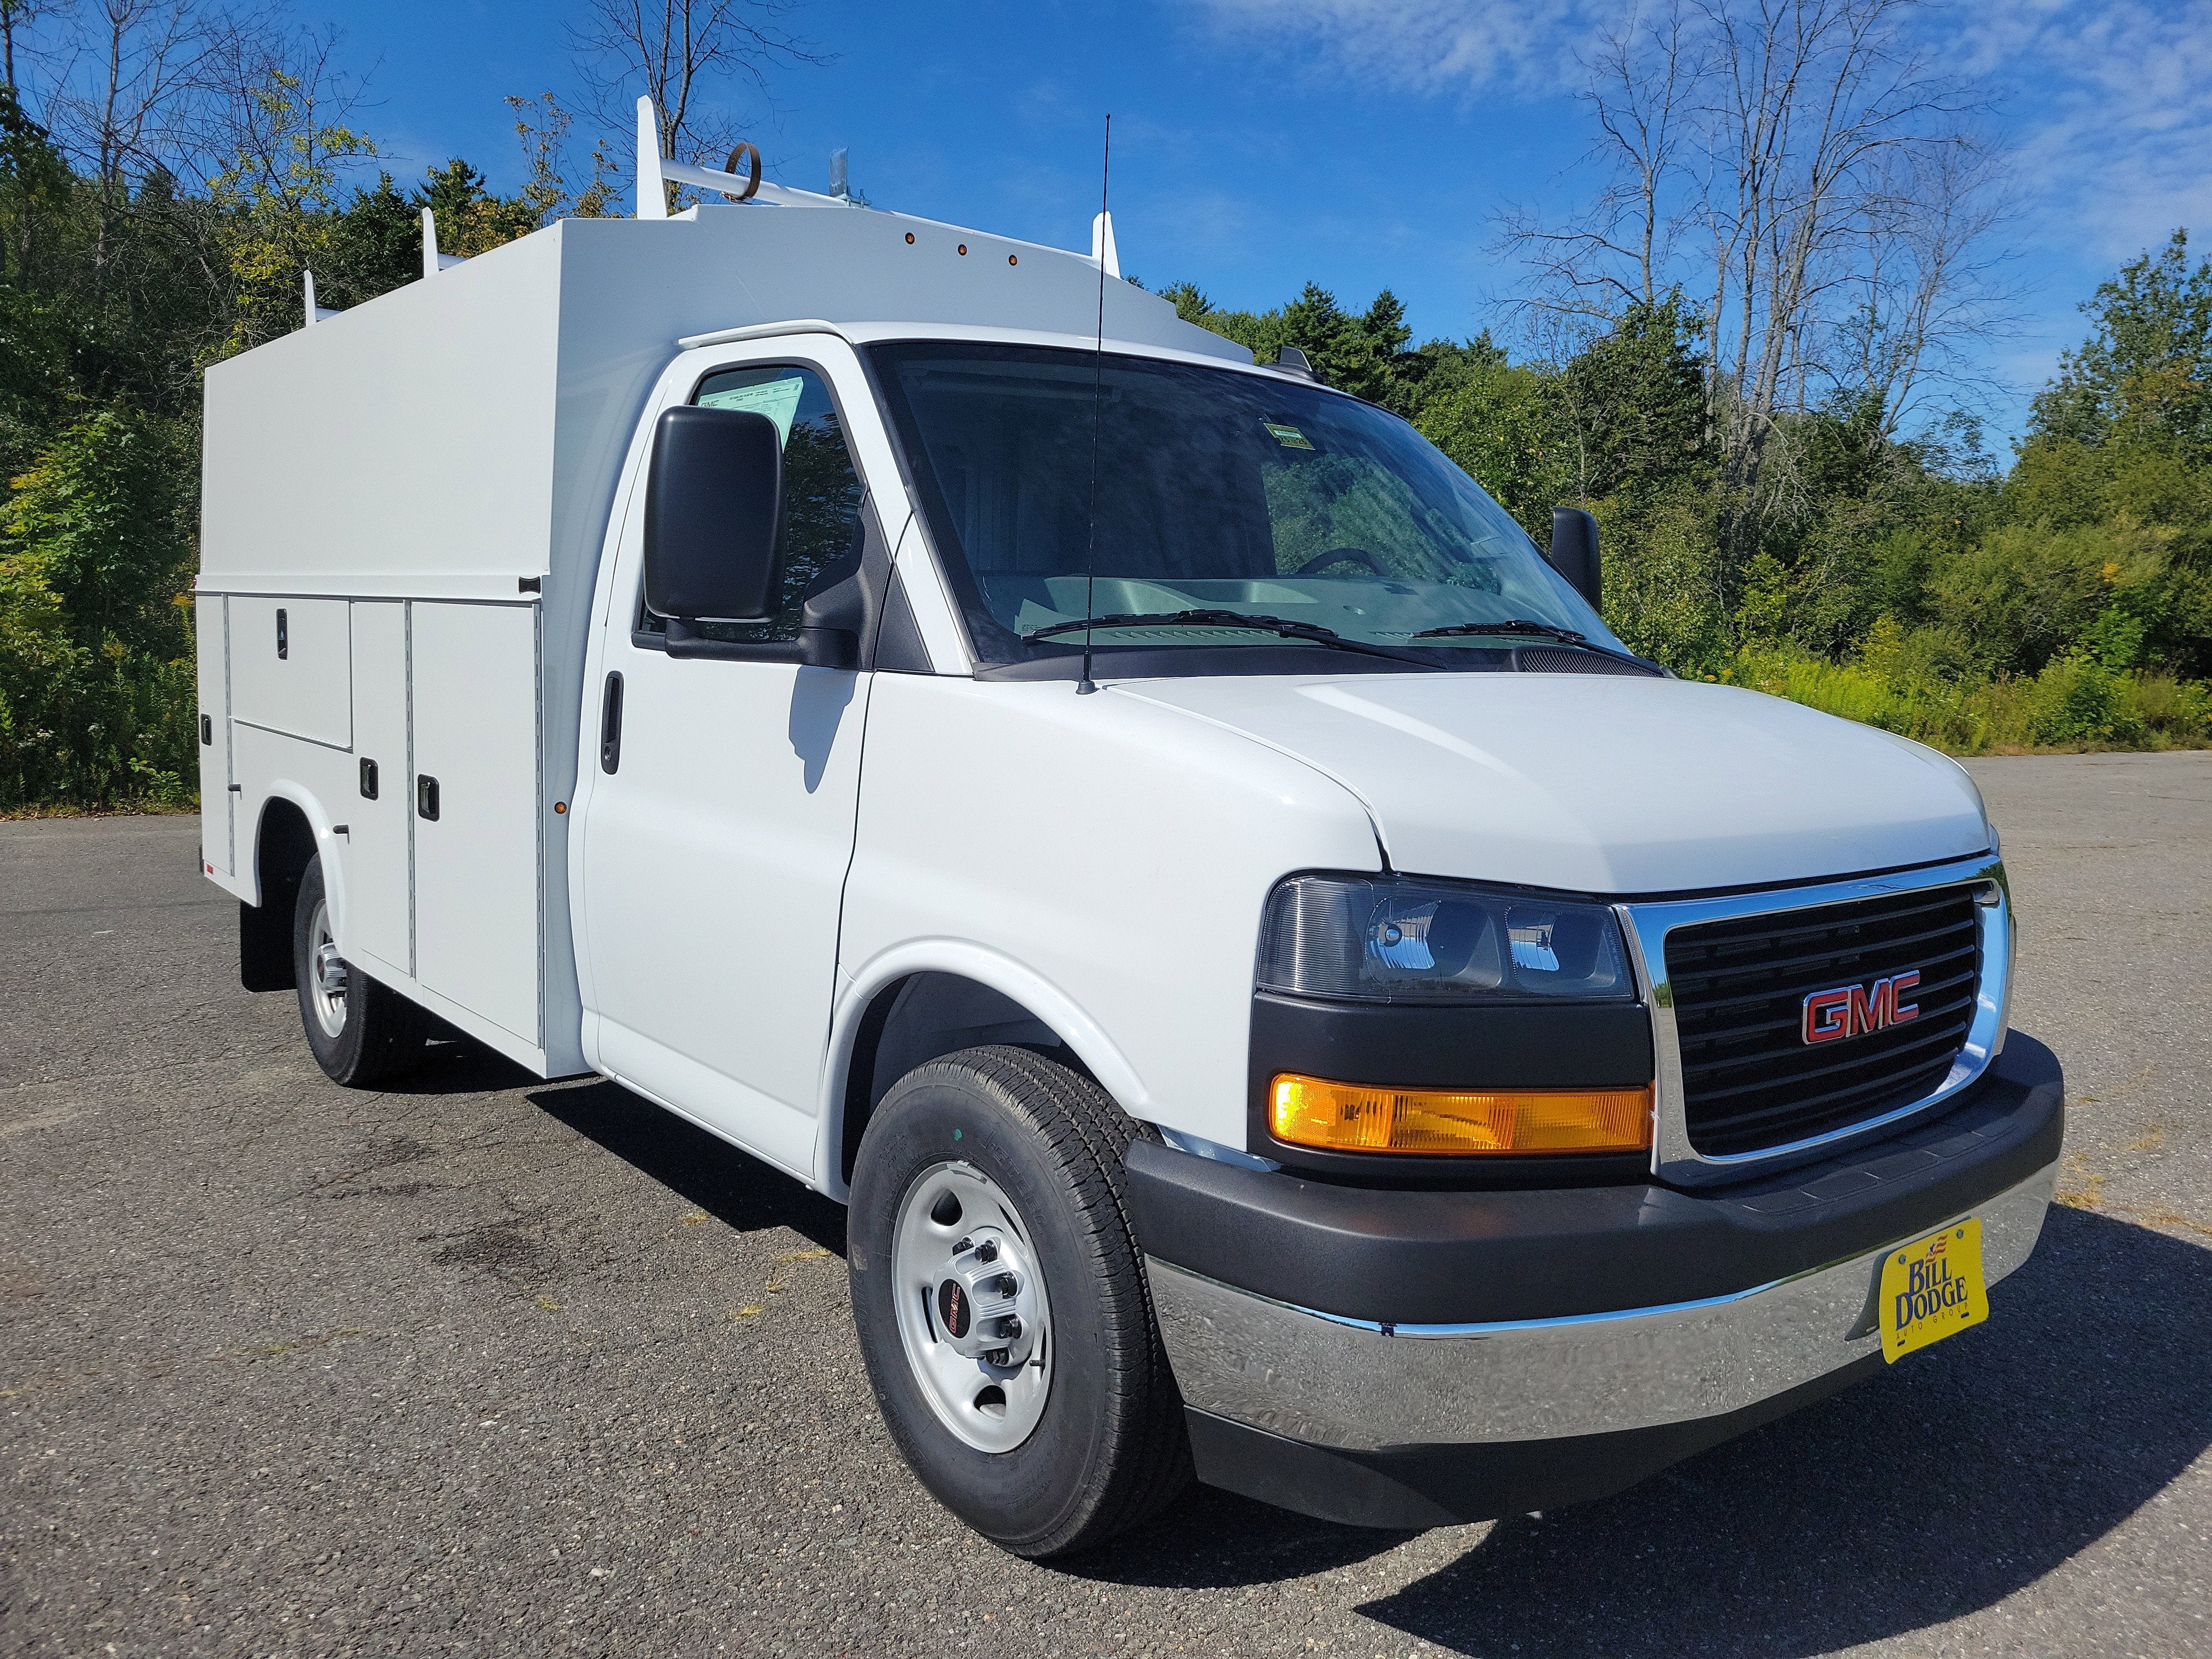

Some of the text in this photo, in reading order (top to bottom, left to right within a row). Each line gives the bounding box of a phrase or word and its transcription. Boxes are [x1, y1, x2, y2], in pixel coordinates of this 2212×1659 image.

[1802, 970, 1920, 1045] GMC
[1909, 1257, 1953, 1297] BILL
[949, 1283, 961, 1334] GMC
[1895, 1276, 1968, 1331] DODGE
[1896, 1302, 1968, 1340] AUTO GROUP
